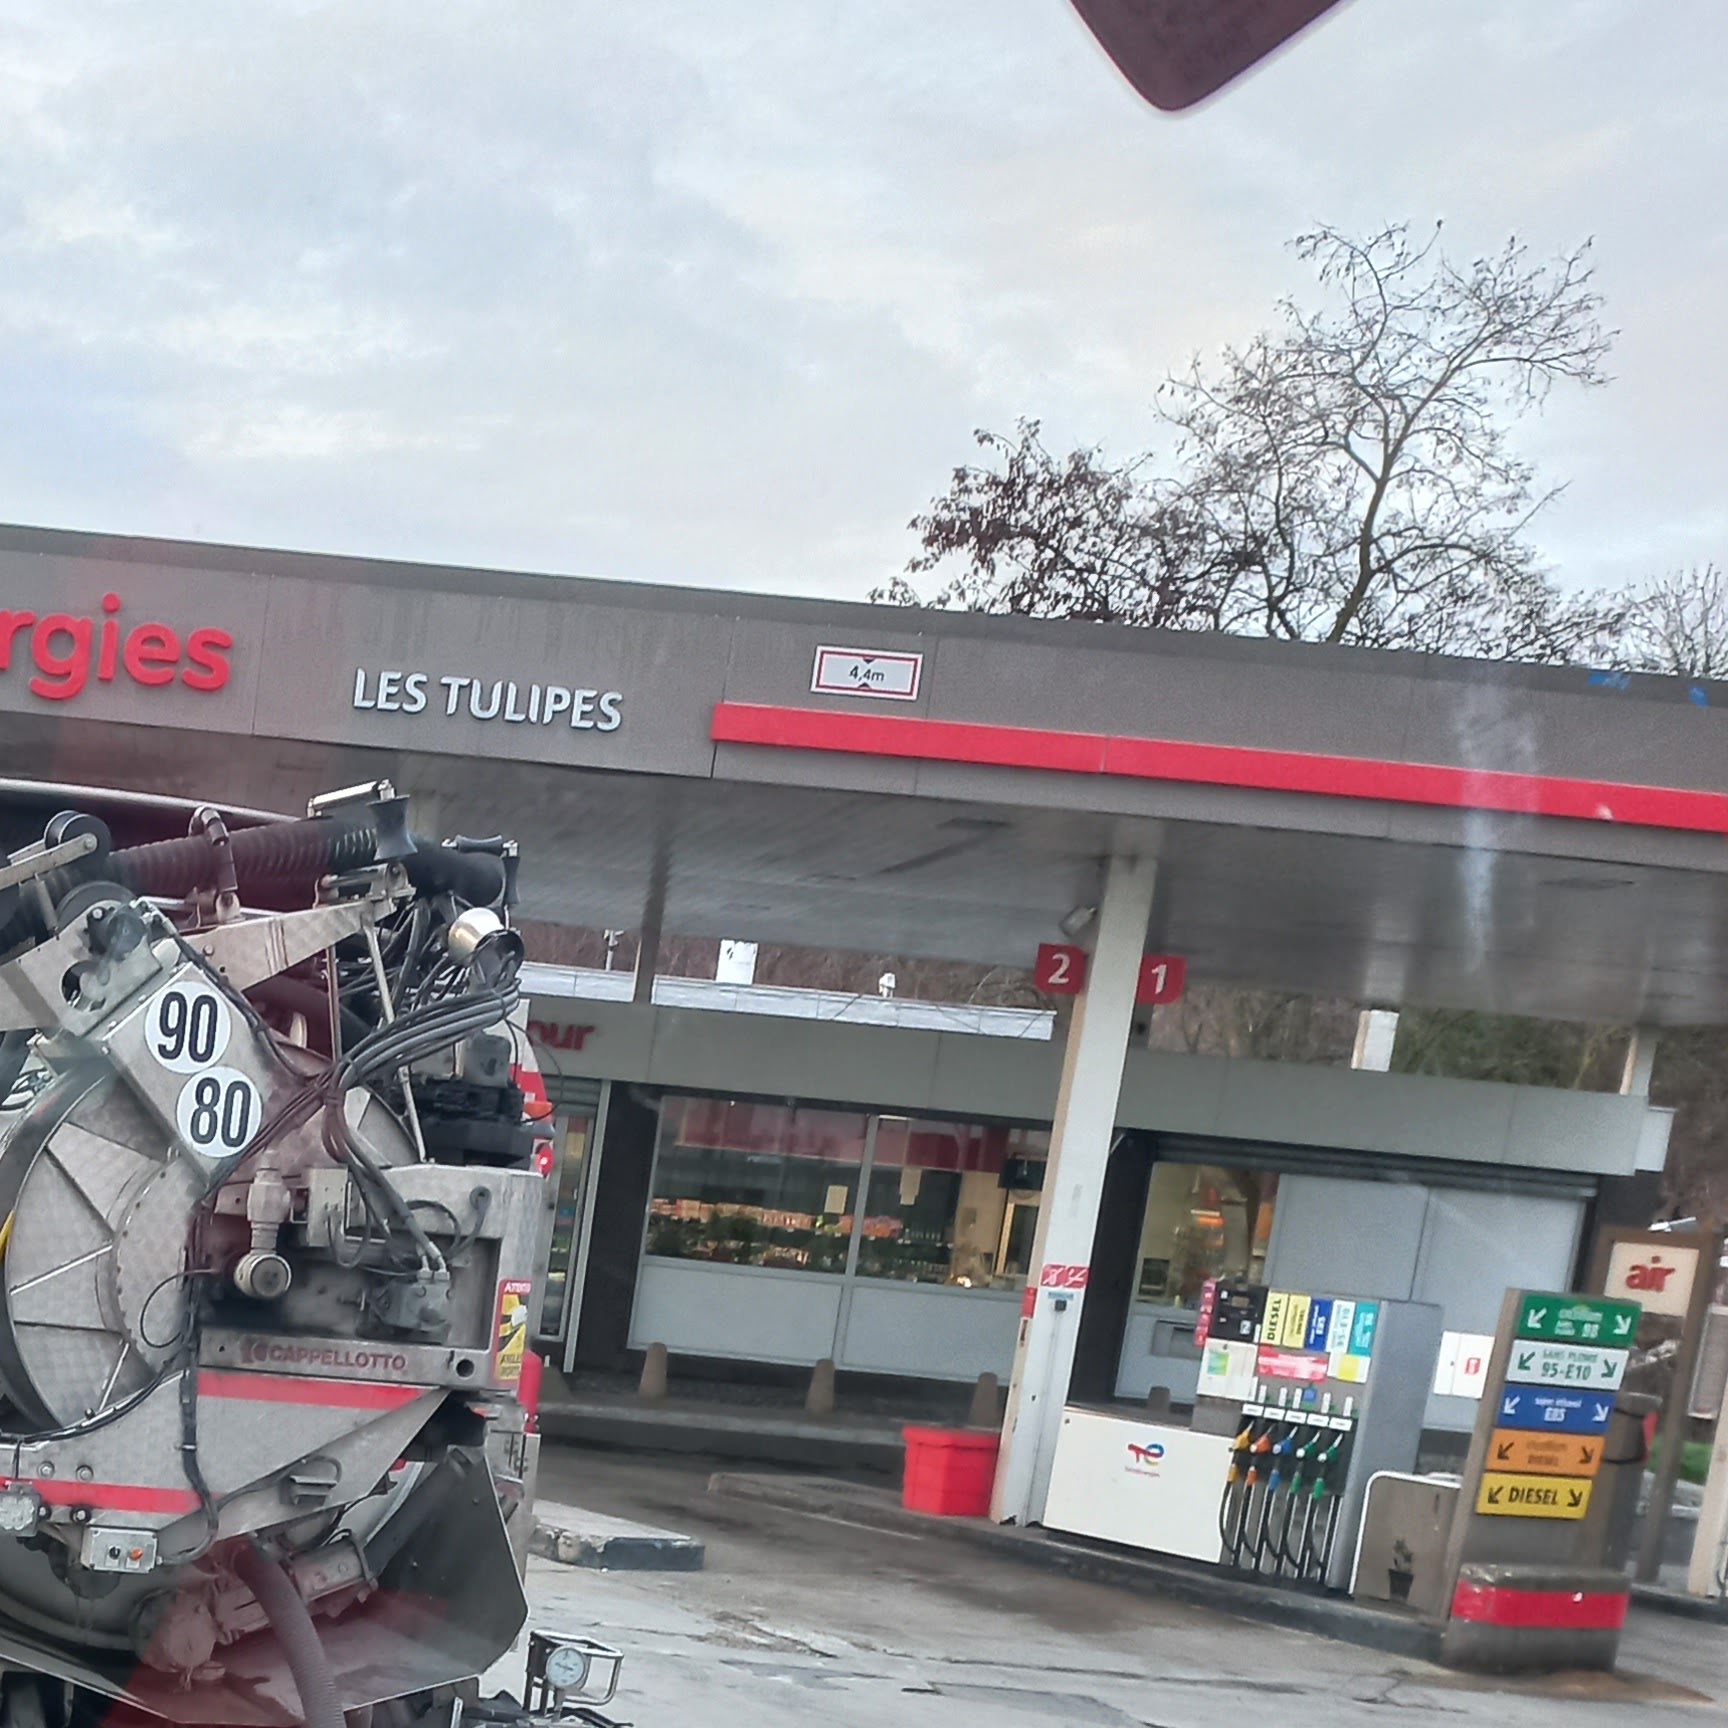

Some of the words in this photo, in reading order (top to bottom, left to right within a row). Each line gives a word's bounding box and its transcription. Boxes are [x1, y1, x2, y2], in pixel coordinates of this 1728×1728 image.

[849, 665, 884, 682] 4,4m
[353, 667, 428, 713] LES
[440, 676, 623, 731] TULIPES
[1048, 953, 1071, 984] 2
[1151, 964, 1167, 995] 1
[157, 991, 218, 1063] 90
[190, 1077, 251, 1148] 80
[1626, 1256, 1676, 1293] air
[1267, 1299, 1282, 1341] DIESEL
[270, 1344, 407, 1371] CAPPELLOTTO
[1541, 1362, 1592, 1380] 95-E10
[1508, 1486, 1558, 1506] DIESEL
